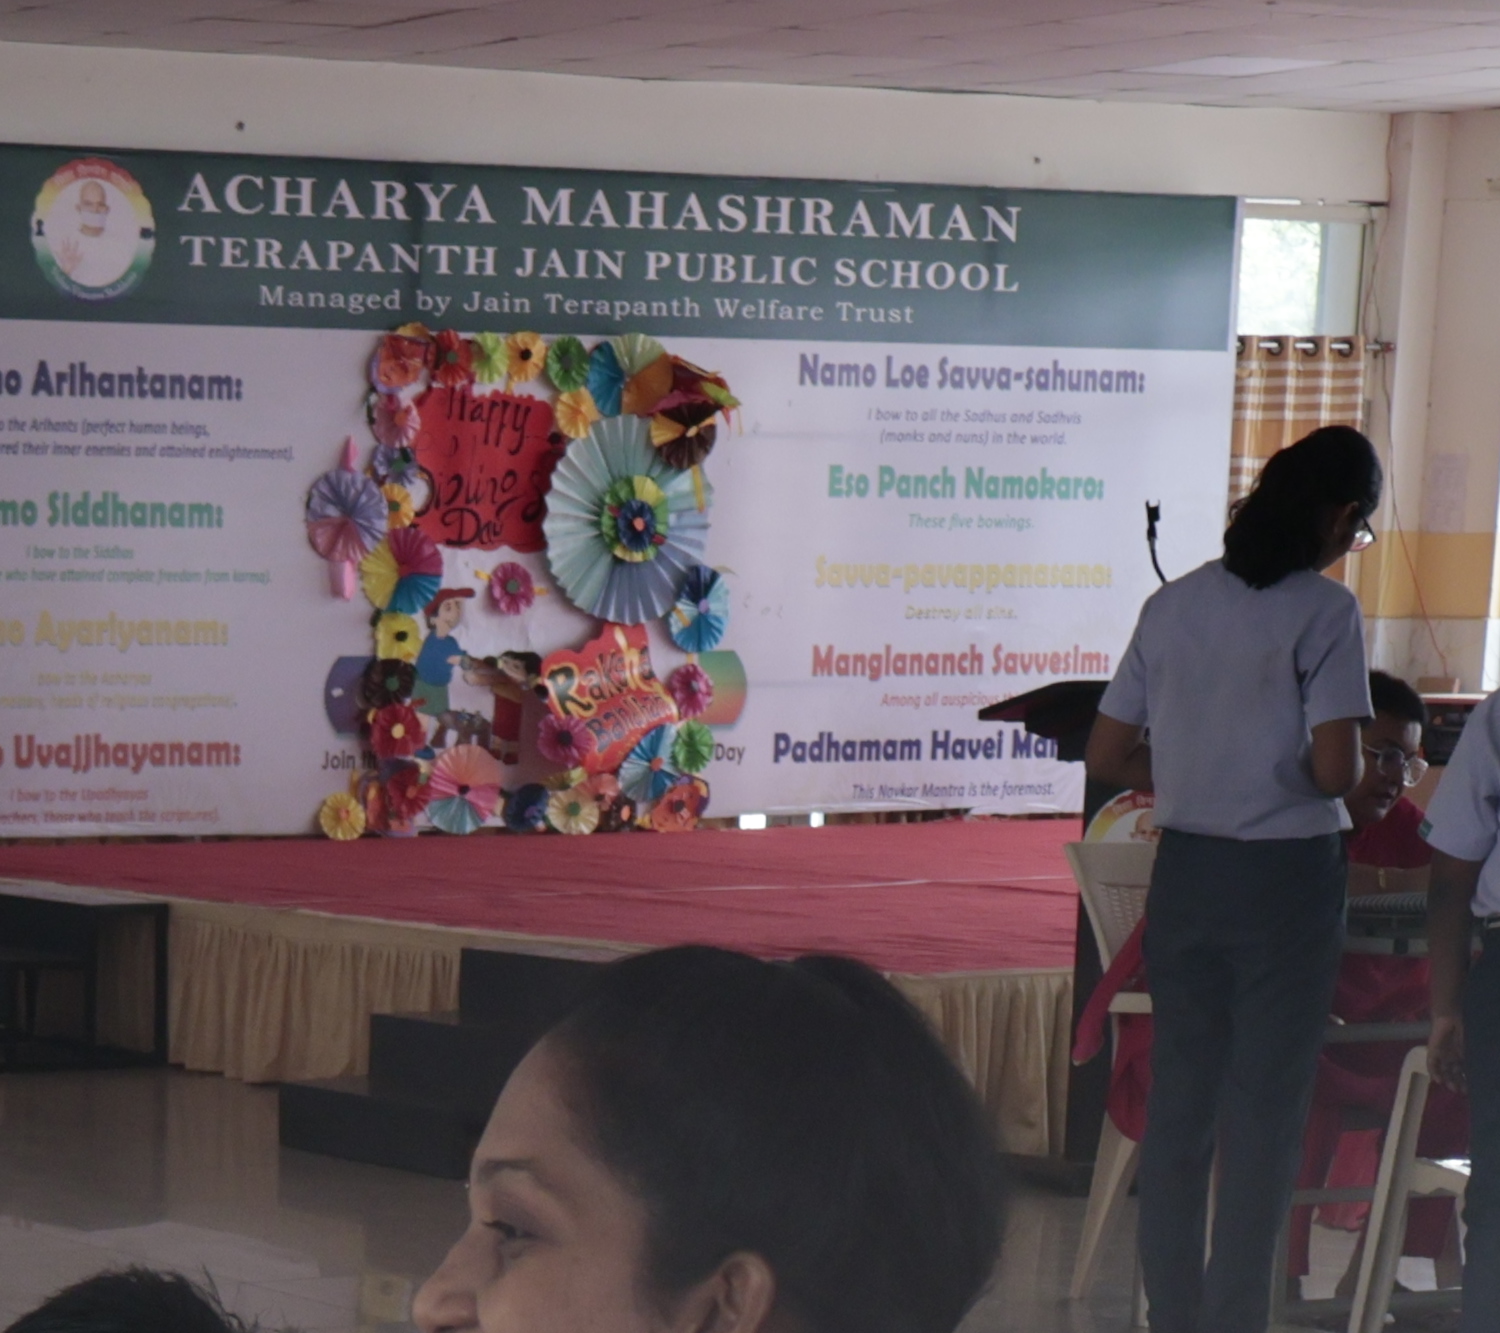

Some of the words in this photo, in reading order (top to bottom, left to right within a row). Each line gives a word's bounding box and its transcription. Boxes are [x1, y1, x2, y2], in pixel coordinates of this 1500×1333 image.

[177, 172, 498, 224] ACHARYA
[521, 186, 1022, 243] MAHASHRAMAN
[180, 235, 498, 277] TERAPANTH
[515, 247, 626, 280] JAIN
[644, 250, 818, 287] PUBLIC
[834, 258, 1020, 293] SCHOOL
[259, 284, 402, 314] Managed
[416, 289, 451, 317] by
[463, 291, 531, 315] Jain
[543, 292, 701, 320] Terapanth
[714, 298, 825, 322] Welfare
[835, 301, 915, 325] Trust
[31, 359, 243, 400] Arihantanam:
[798, 352, 877, 388] Namo
[884, 354, 930, 389] Loe
[937, 356, 1146, 394] Savva-sahunam:
[446, 384, 533, 456] Happy
[875, 408, 902, 421] bow
[905, 409, 919, 421] to
[921, 408, 937, 421] all
[940, 408, 960, 422] the
[963, 409, 1007, 423] Sadhus
[1009, 410, 1034, 424] and
[1036, 411, 1082, 425] Sadhvis
[879, 430, 925, 445] (monks
[927, 430, 952, 444] and
[954, 430, 990, 446] nuns)
[991, 431, 1003, 444] in
[1006, 431, 1027, 445] the
[1030, 432, 1067, 446] world.
[827, 463, 870, 499] Eso
[877, 464, 956, 500] Panch
[963, 466, 1105, 501] Namokaro:
[46, 489, 224, 529] Siddhanam:
[907, 513, 946, 529] These
[947, 513, 974, 531] five
[976, 514, 1035, 532] bowings.
[811, 643, 985, 682] Manglananch
[992, 643, 1110, 677] Savvesim:
[880, 693, 922, 711] Among
[924, 692, 939, 707] all
[13, 733, 241, 774] Uvajjhayanam:
[321, 749, 357, 770] Join
[714, 742, 747, 767] Day
[772, 731, 923, 764] Padhamam
[931, 729, 1004, 761] Havei
[851, 783, 875, 800] This
[921, 782, 966, 799] Mantra
[980, 781, 1000, 798] the
